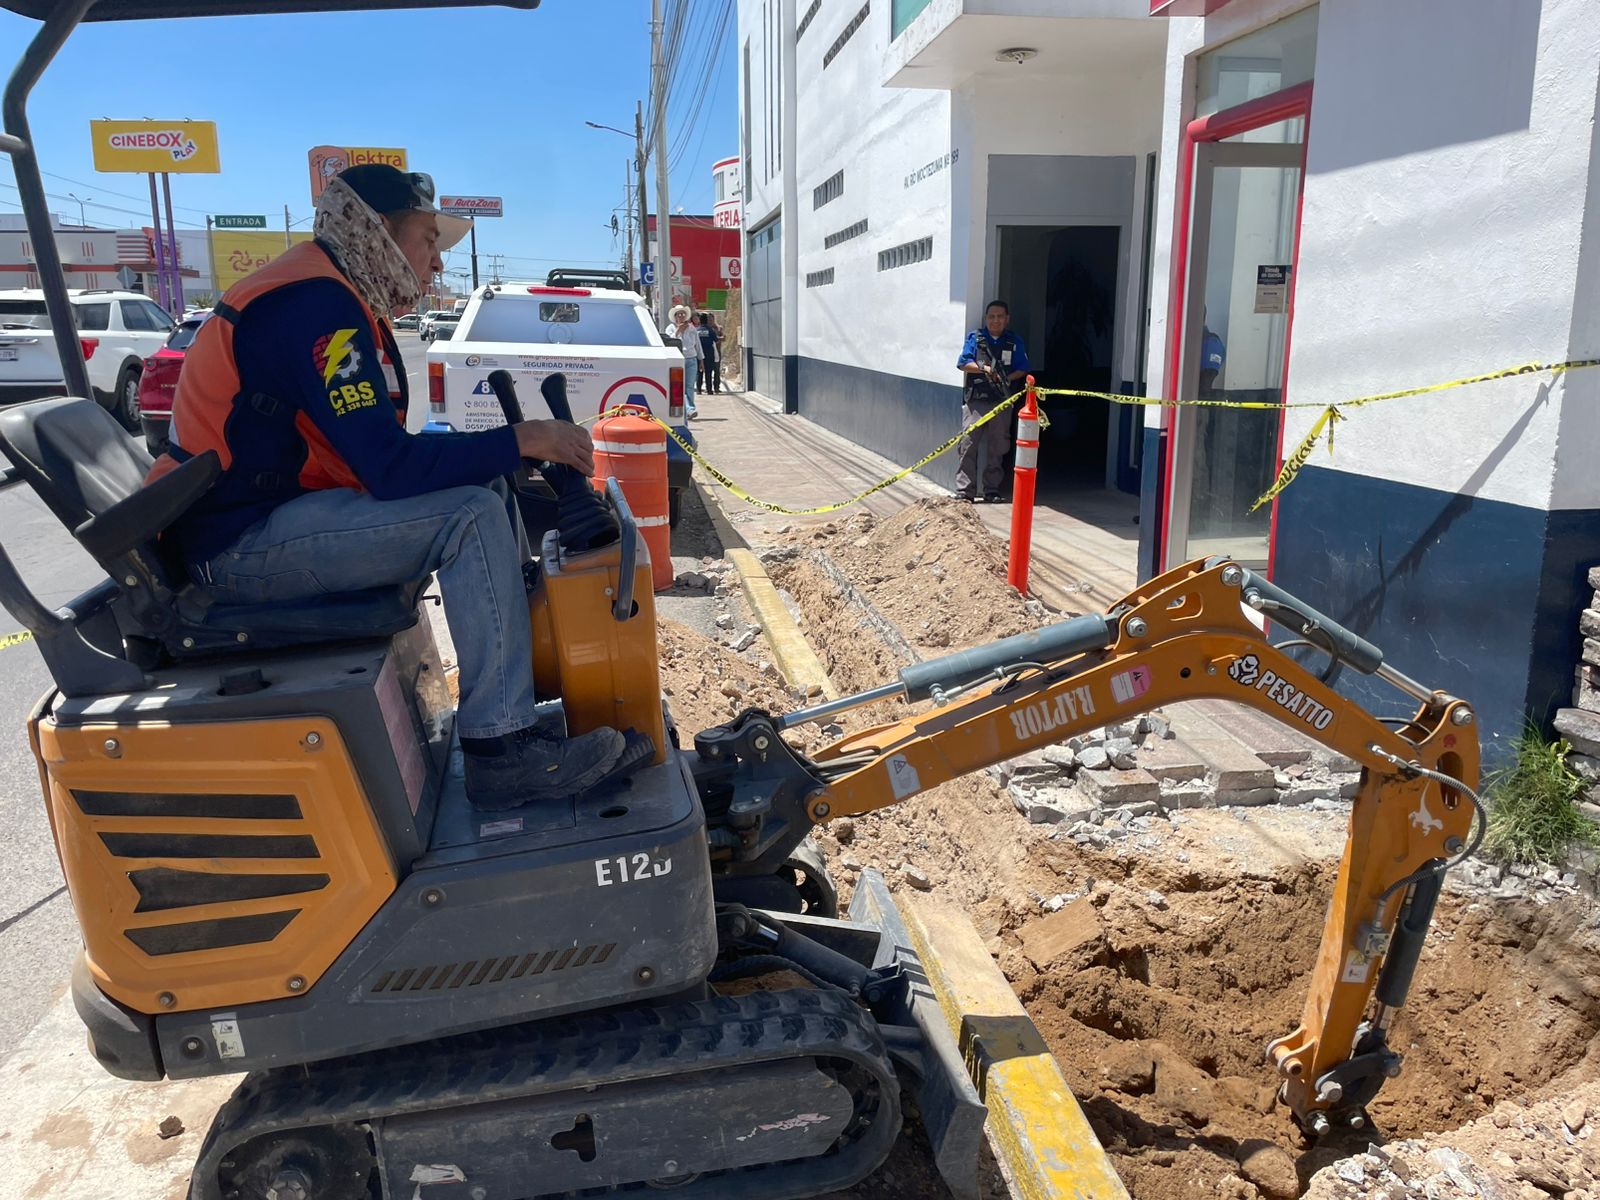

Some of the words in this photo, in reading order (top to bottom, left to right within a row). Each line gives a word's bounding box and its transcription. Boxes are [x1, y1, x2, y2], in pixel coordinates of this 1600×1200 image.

[111, 131, 182, 148] CINEBOX
[173, 141, 196, 160] PLAY
[350, 150, 403, 167] lektra
[455, 198, 500, 208] AutoZone
[220, 217, 261, 226] ENTRADA
[523, 361, 562, 369] SEGURIDAD
[329, 381, 375, 410] CBS
[473, 400, 488, 409] 800
[1255, 669, 1335, 730] PESATTO
[1009, 684, 1096, 740] RAPTOR
